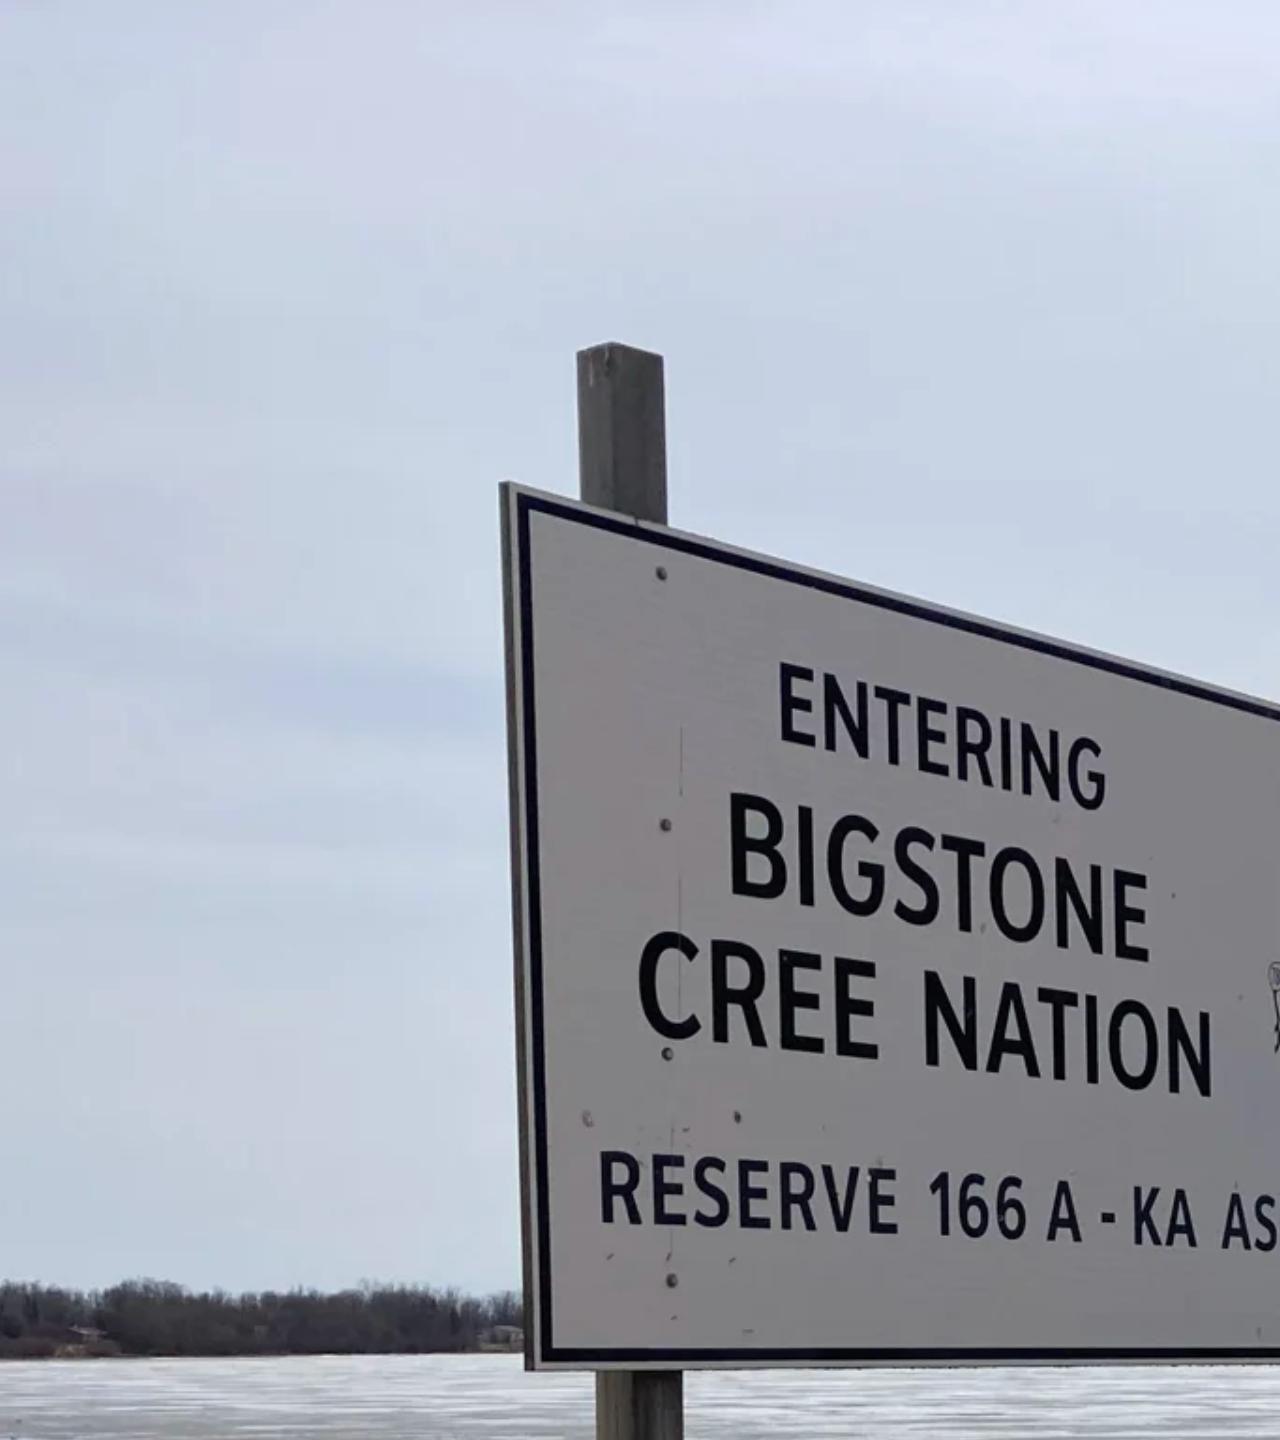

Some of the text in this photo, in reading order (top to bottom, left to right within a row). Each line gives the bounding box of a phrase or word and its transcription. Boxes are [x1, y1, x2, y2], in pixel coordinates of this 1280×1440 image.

[779, 661, 1107, 812] ENTERING
[729, 791, 1150, 964] BIGSTONE
[637, 930, 1213, 1099] CREE NATION
[600, 1150, 899, 1236] RESERVE
[928, 1171, 1029, 1241] 166
[1046, 1180, 1083, 1243] A
[1101, 1212, 1115, 1223] -
[1133, 1185, 1198, 1249] KA
